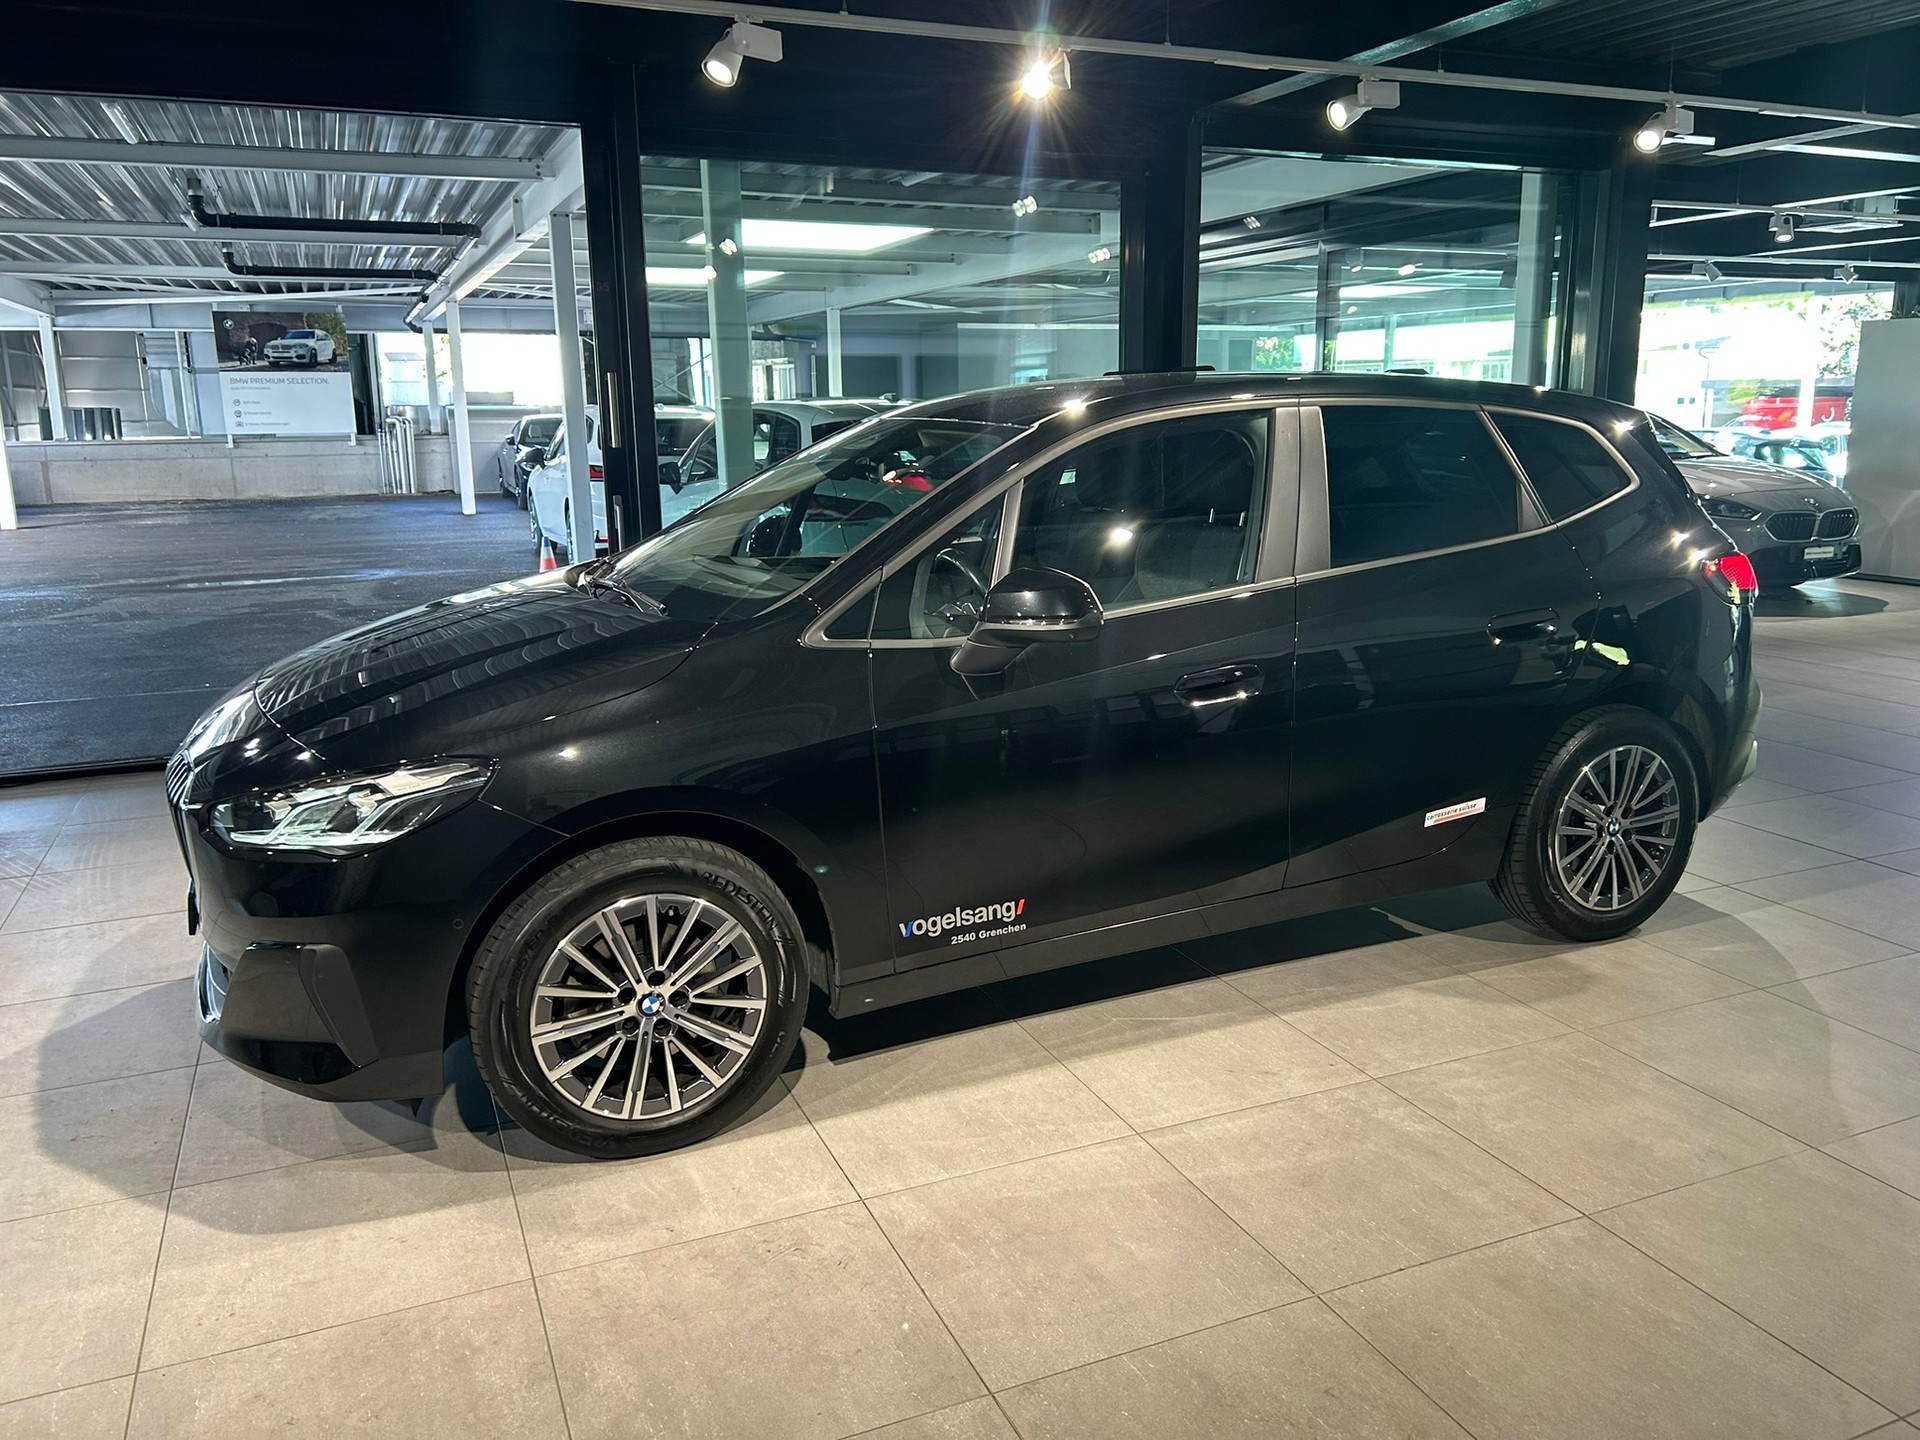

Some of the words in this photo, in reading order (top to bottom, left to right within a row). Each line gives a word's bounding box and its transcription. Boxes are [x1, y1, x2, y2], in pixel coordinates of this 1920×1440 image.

[229, 377, 249, 385] BMW
[249, 377, 286, 385] PREMIUM
[286, 377, 330, 385] SELECTION.
[1458, 803, 1477, 813] suisse
[950, 931, 976, 945] 2540
[977, 922, 1027, 939] Grenchen
